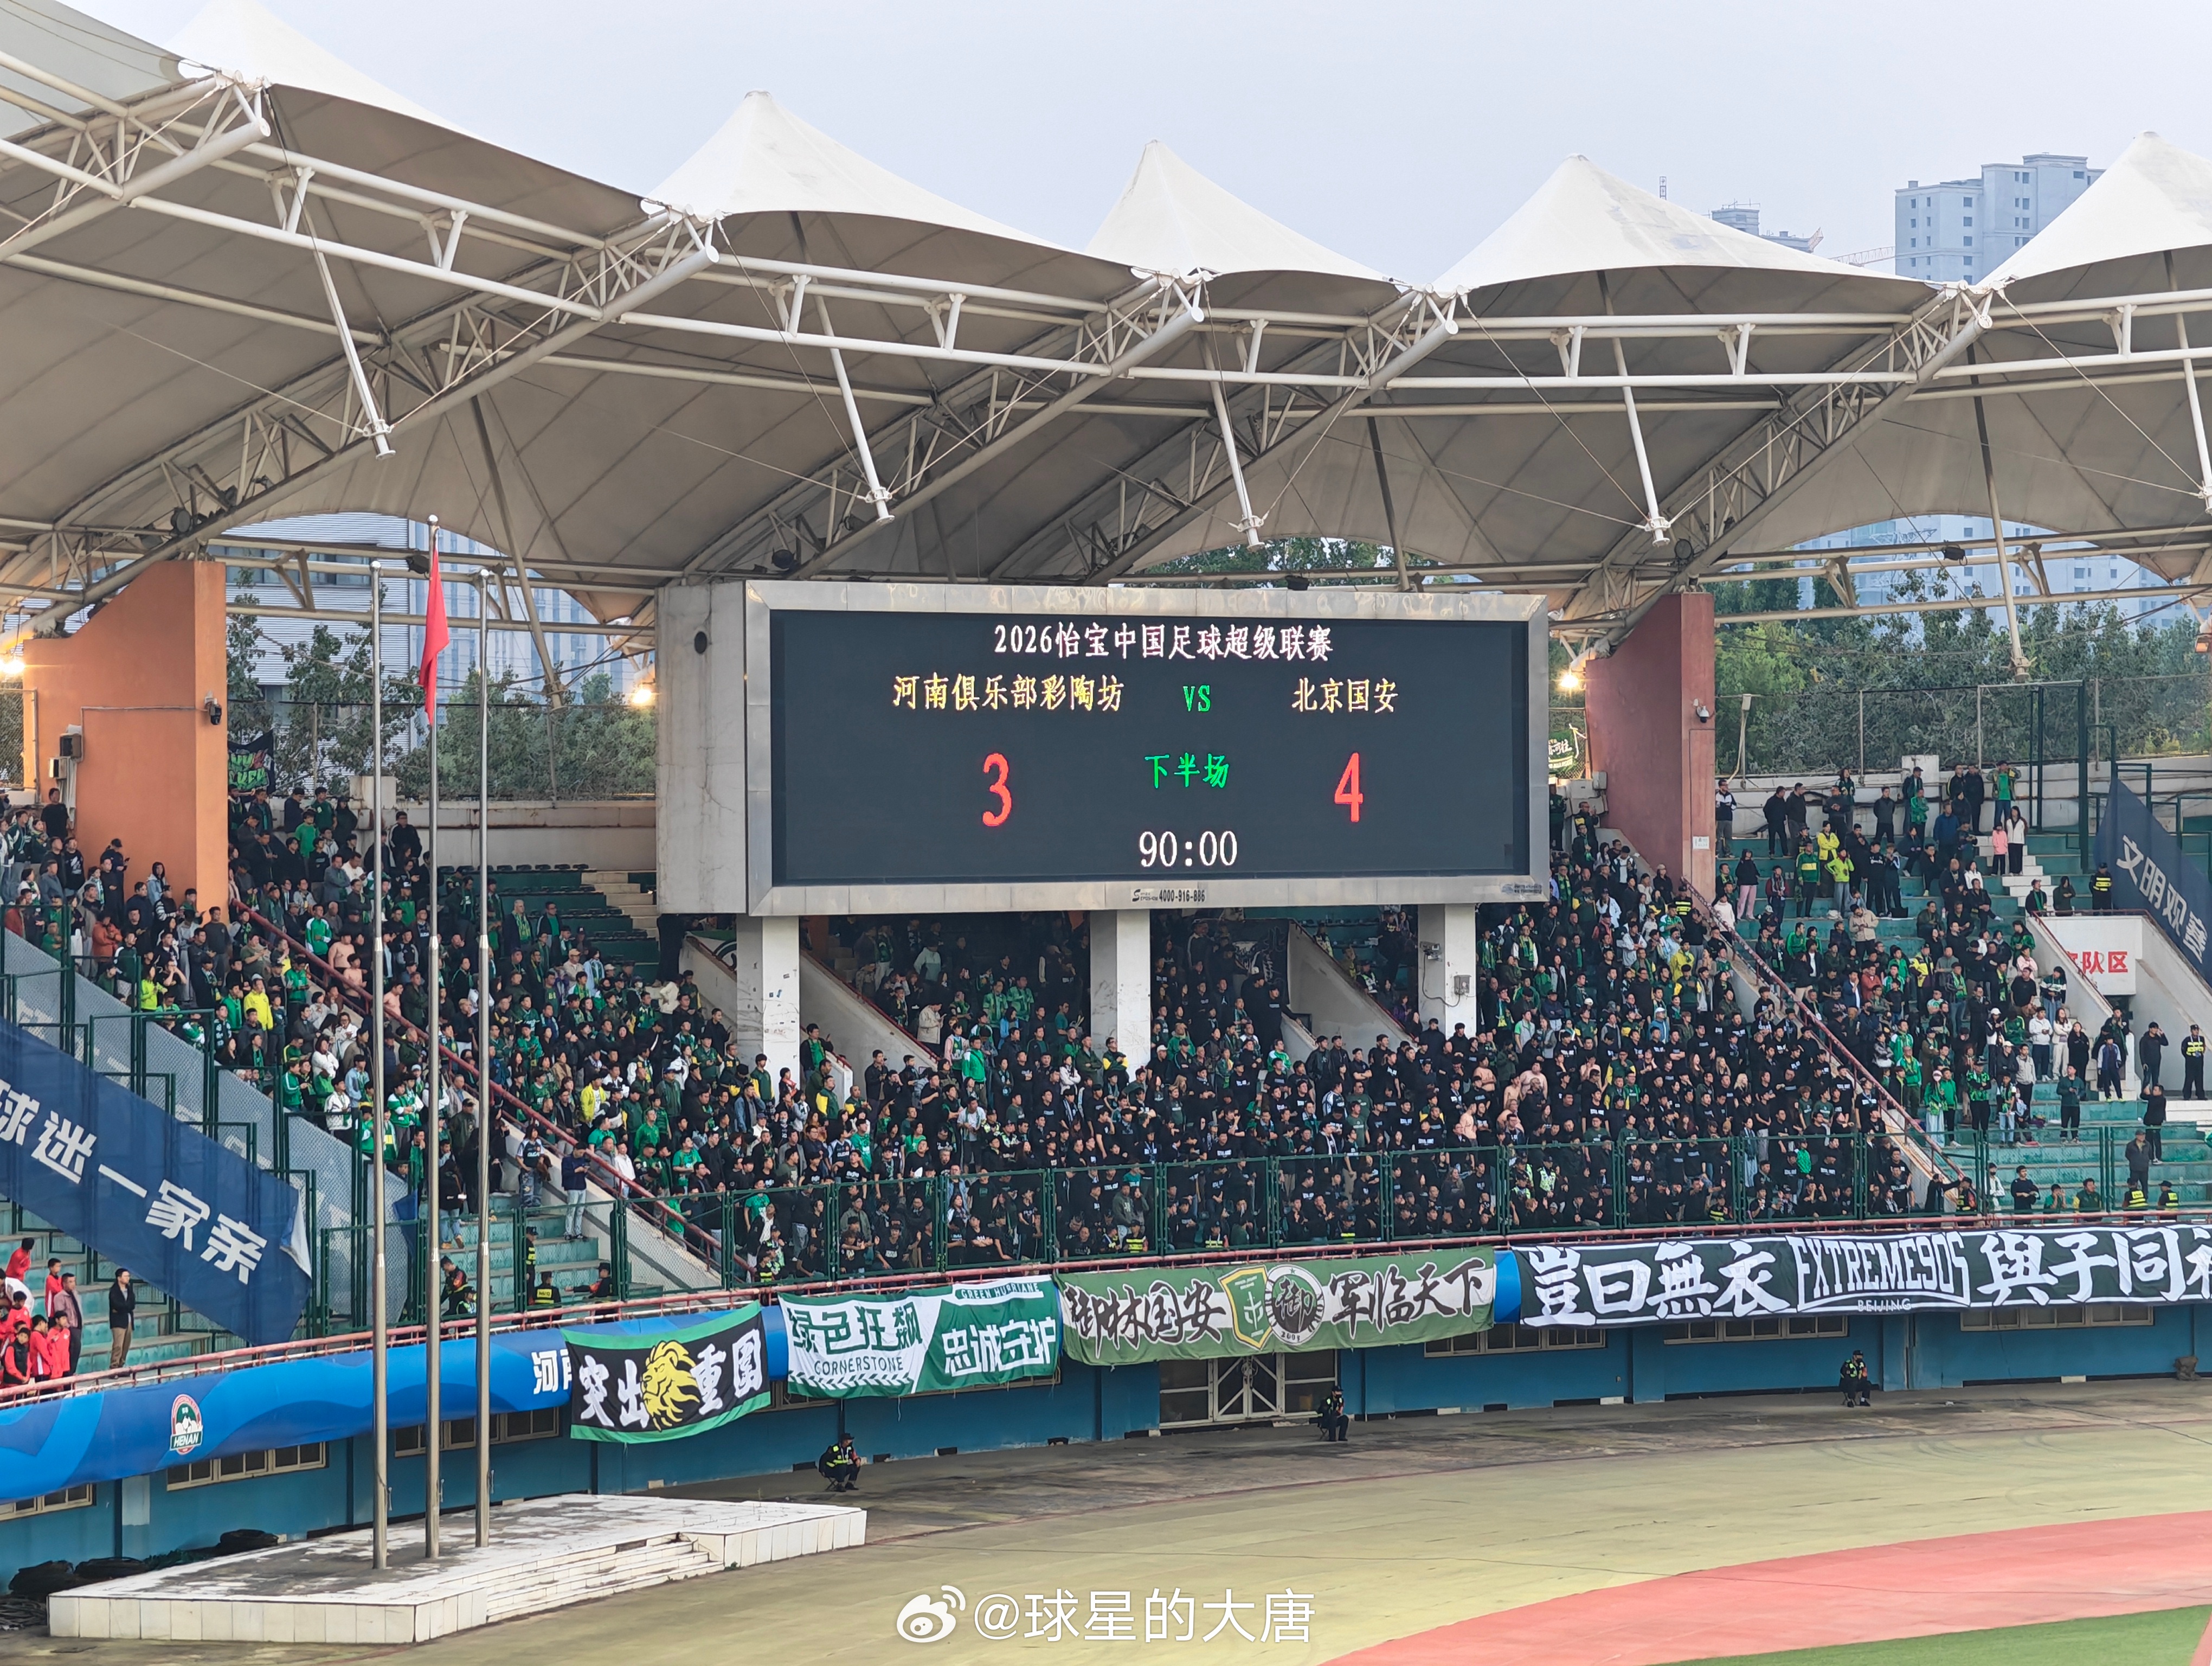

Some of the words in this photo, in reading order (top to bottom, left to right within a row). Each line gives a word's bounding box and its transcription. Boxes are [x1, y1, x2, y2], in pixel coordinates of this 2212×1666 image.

[994, 623, 1334, 662] 2026怡宝中国足球超级联赛
[893, 674, 1125, 712] 河南俱乐部彩陶坊
[1182, 685, 1211, 713] VS
[1291, 678, 1399, 714] 北京国安
[1145, 752, 1229, 789] 下半场
[1334, 752, 1364, 823] 4
[982, 753, 1013, 827] 3
[1139, 830, 1237, 868] 90:00
[2116, 834, 2208, 964] 文明观赛
[0, 1079, 267, 1285] 球迷一家亲
[961, 1289, 992, 1299] GREEN
[1857, 1298, 1912, 1312] BEIJING
[941, 1316, 1057, 1377] 忠诚守护
[814, 1356, 904, 1376] CORNERSTONE
[173, 1432, 200, 1448] HENAN
